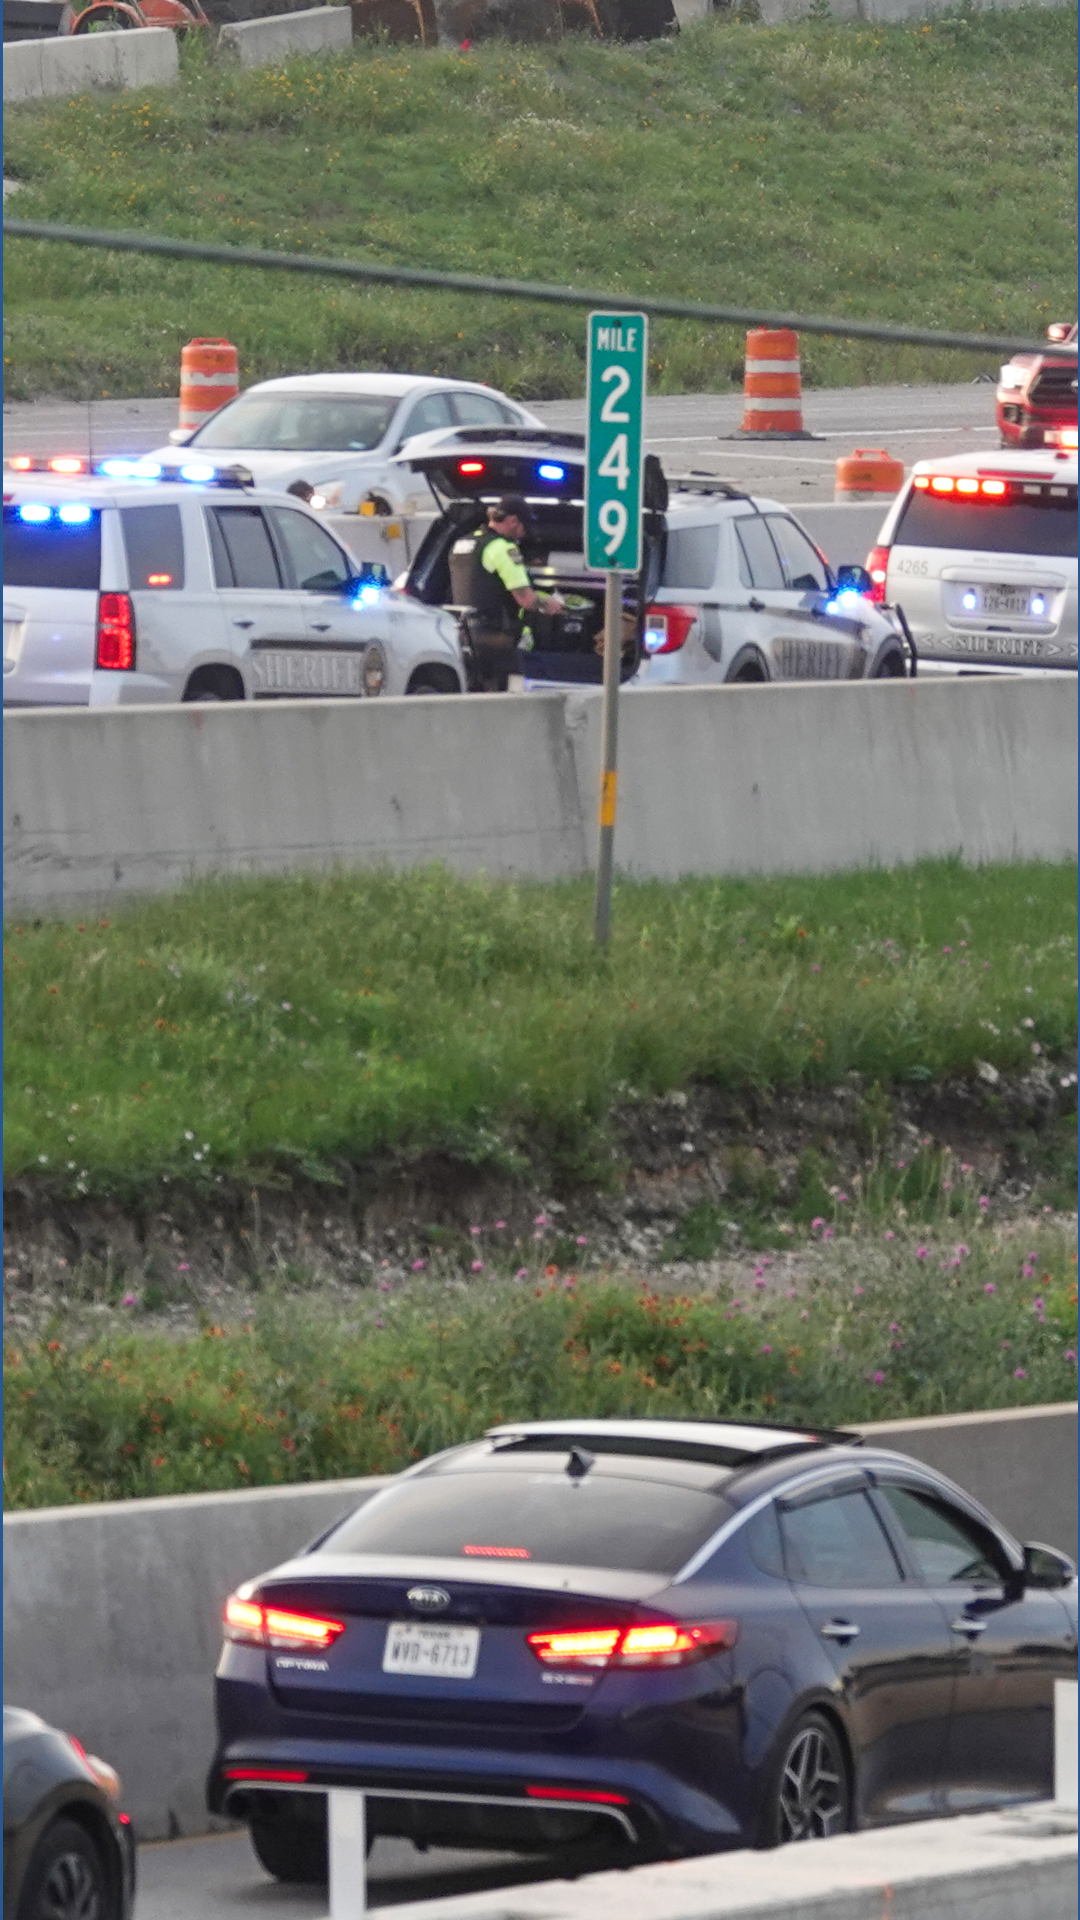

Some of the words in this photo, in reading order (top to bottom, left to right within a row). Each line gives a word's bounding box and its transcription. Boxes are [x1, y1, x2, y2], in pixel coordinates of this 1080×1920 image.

[597, 327, 637, 351] MILE
[598, 365, 631, 556] 249
[896, 559, 929, 575] 4265
[956, 636, 1043, 656] SHERIFF
[252, 653, 360, 689] SHERIFF
